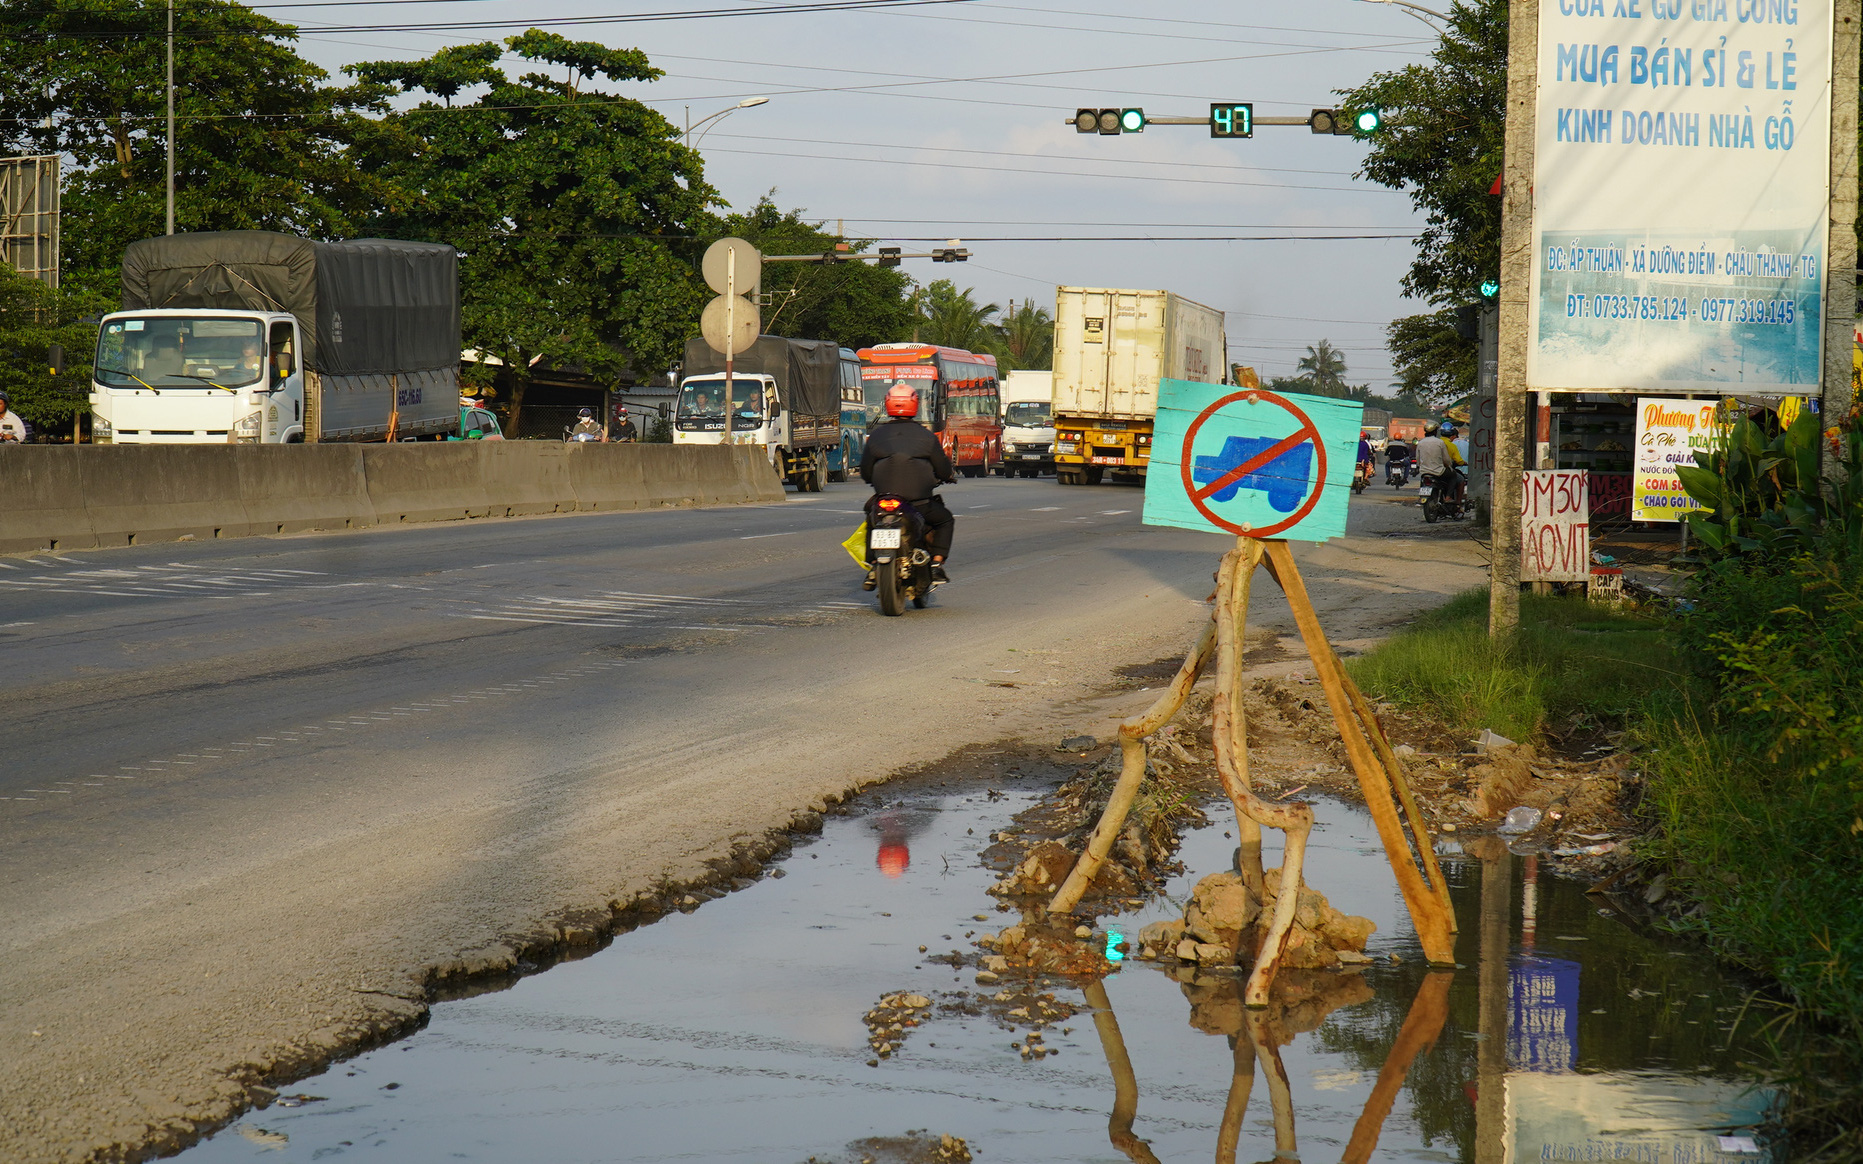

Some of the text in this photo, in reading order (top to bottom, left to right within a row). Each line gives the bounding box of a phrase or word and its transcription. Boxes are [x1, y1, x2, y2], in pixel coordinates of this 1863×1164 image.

[1556, 35, 1797, 90] MUA BÁN SỈ & LẺ
[1214, 106, 1249, 134] 47
[1557, 99, 1795, 151] KINH DOANH NHÀ GỖ
[1548, 247, 1567, 271] ĐC:
[1569, 238, 1584, 271] ẤP
[1587, 242, 1623, 277] THUẬN
[1632, 244, 1646, 273] XÃ
[1650, 244, 1685, 275] DƯỠNG
[1688, 241, 1715, 275] ĐIỀM
[1725, 246, 1753, 277] CHÂU
[1756, 247, 1792, 278] THÀNH
[1802, 255, 1816, 279] TG
[1567, 294, 1590, 318] ĐT:
[1594, 294, 1687, 321] 0733.785.124
[1701, 298, 1794, 324] 0977.319.145
[1644, 403, 1696, 433] Phương
[1656, 432, 1676, 447] Phê
[1640, 464, 1661, 474] NƯỚC
[1665, 450, 1685, 464] GIẢI
